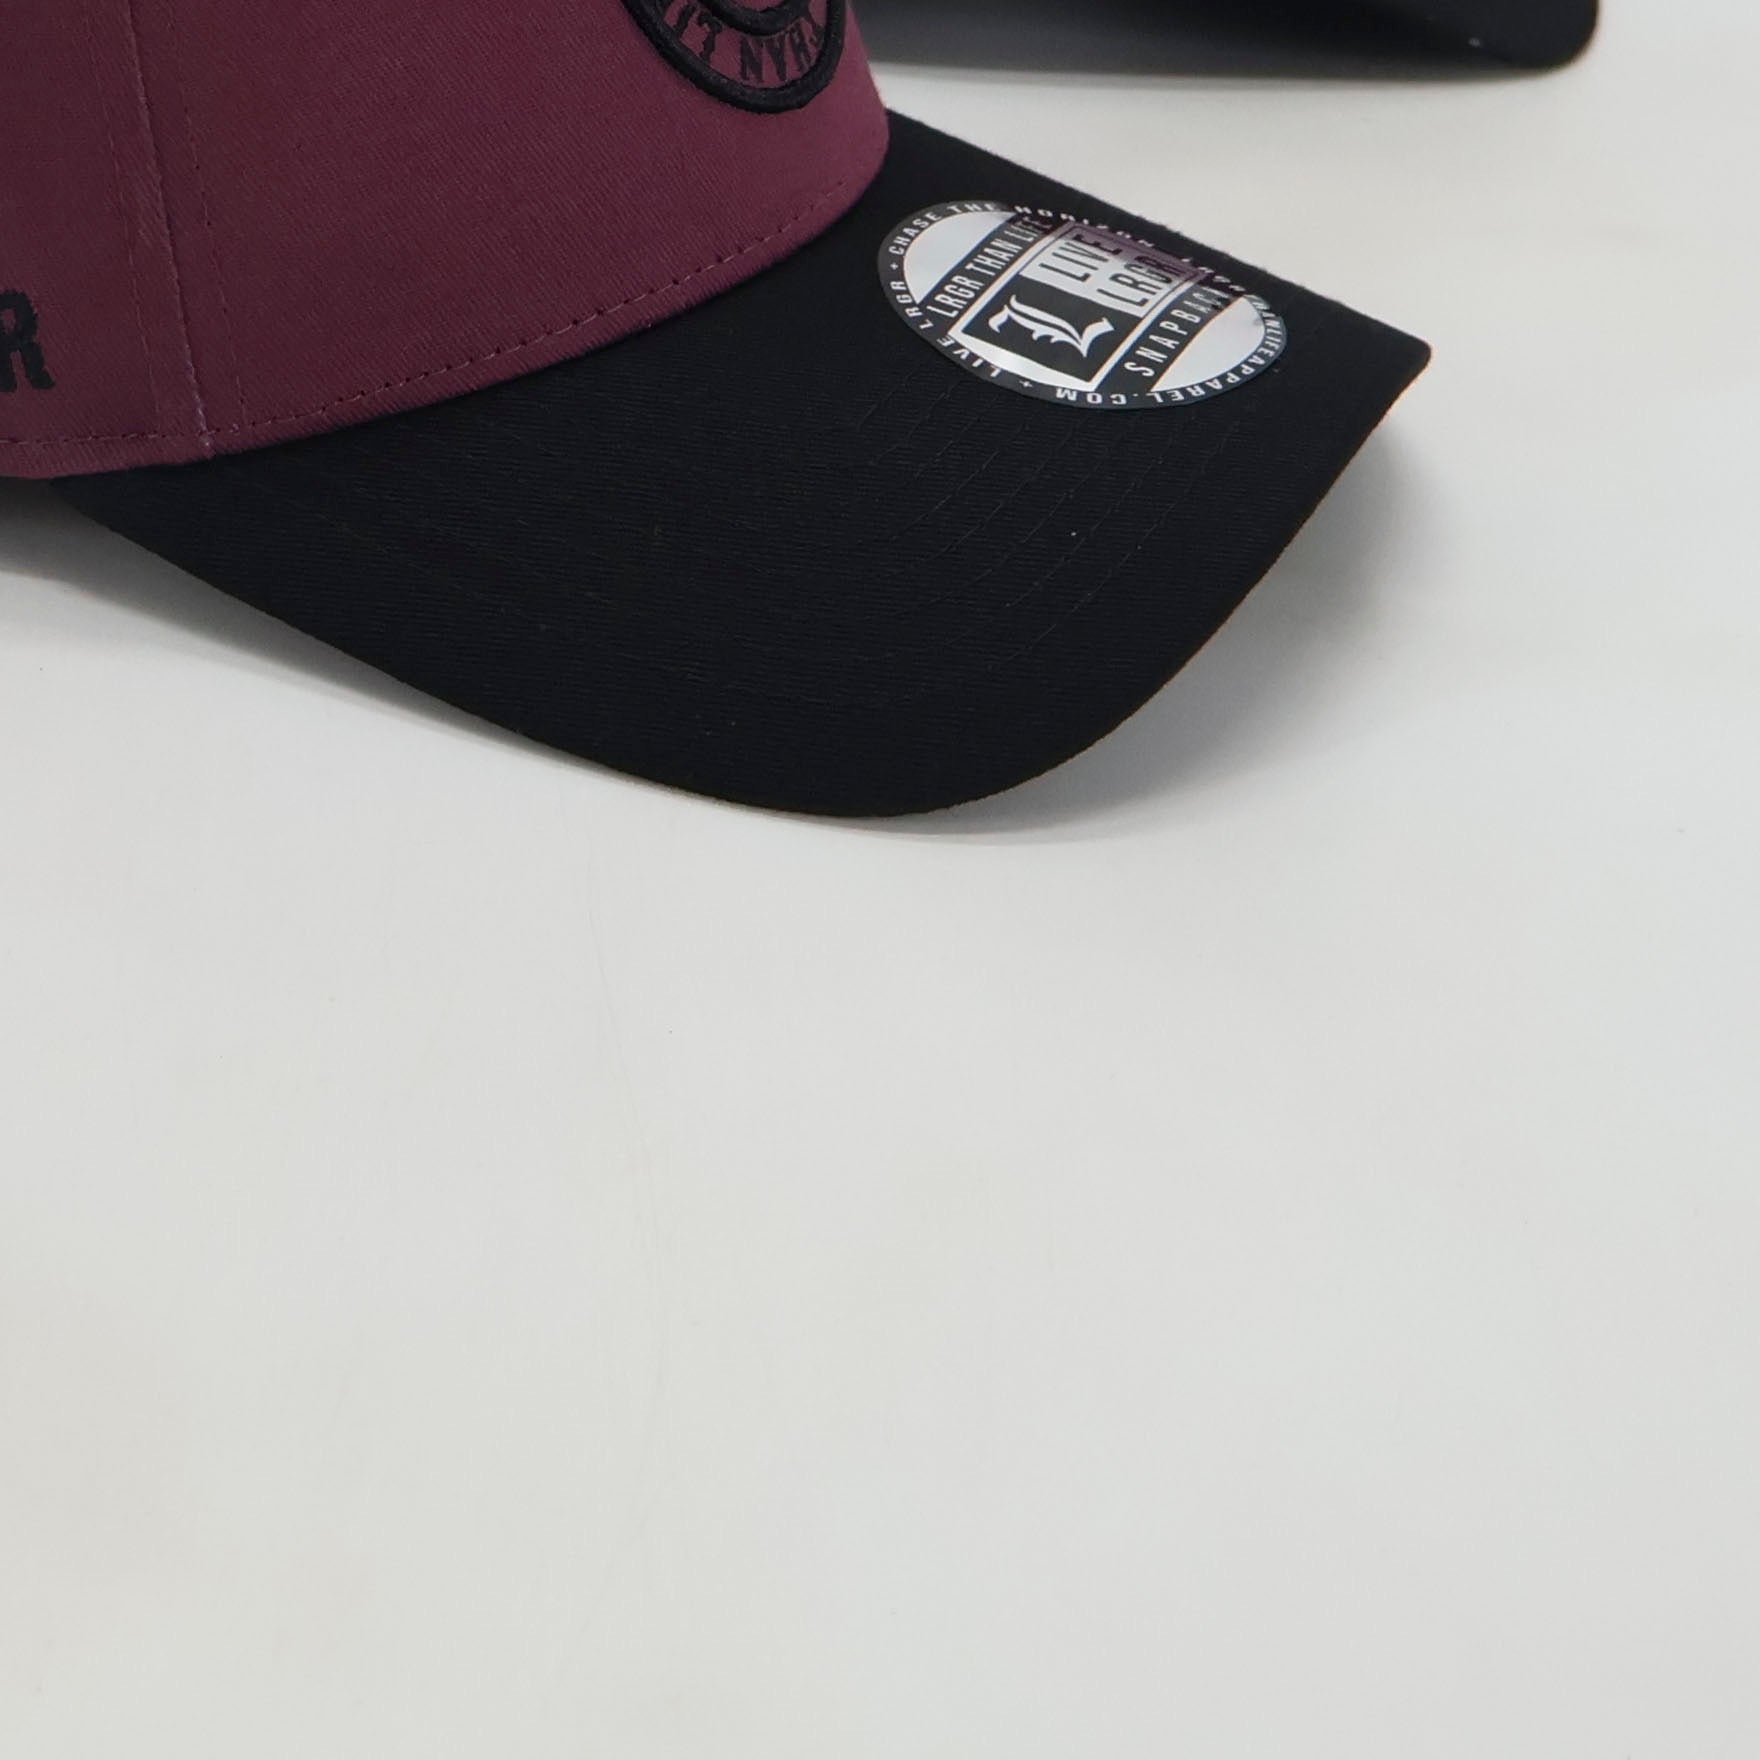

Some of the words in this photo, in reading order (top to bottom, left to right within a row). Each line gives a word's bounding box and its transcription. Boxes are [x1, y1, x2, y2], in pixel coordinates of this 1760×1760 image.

[888, 211, 943, 256] CHASE
[947, 202, 1001, 215] THE
[926, 275, 986, 319] LRGR
[971, 238, 1024, 277] THAN
[1038, 233, 1124, 283] LIVE
[1097, 256, 1186, 308] LRGR
[889, 280, 935, 331] LRGR
[987, 293, 1116, 359] L
[936, 335, 1003, 379] LIVE
